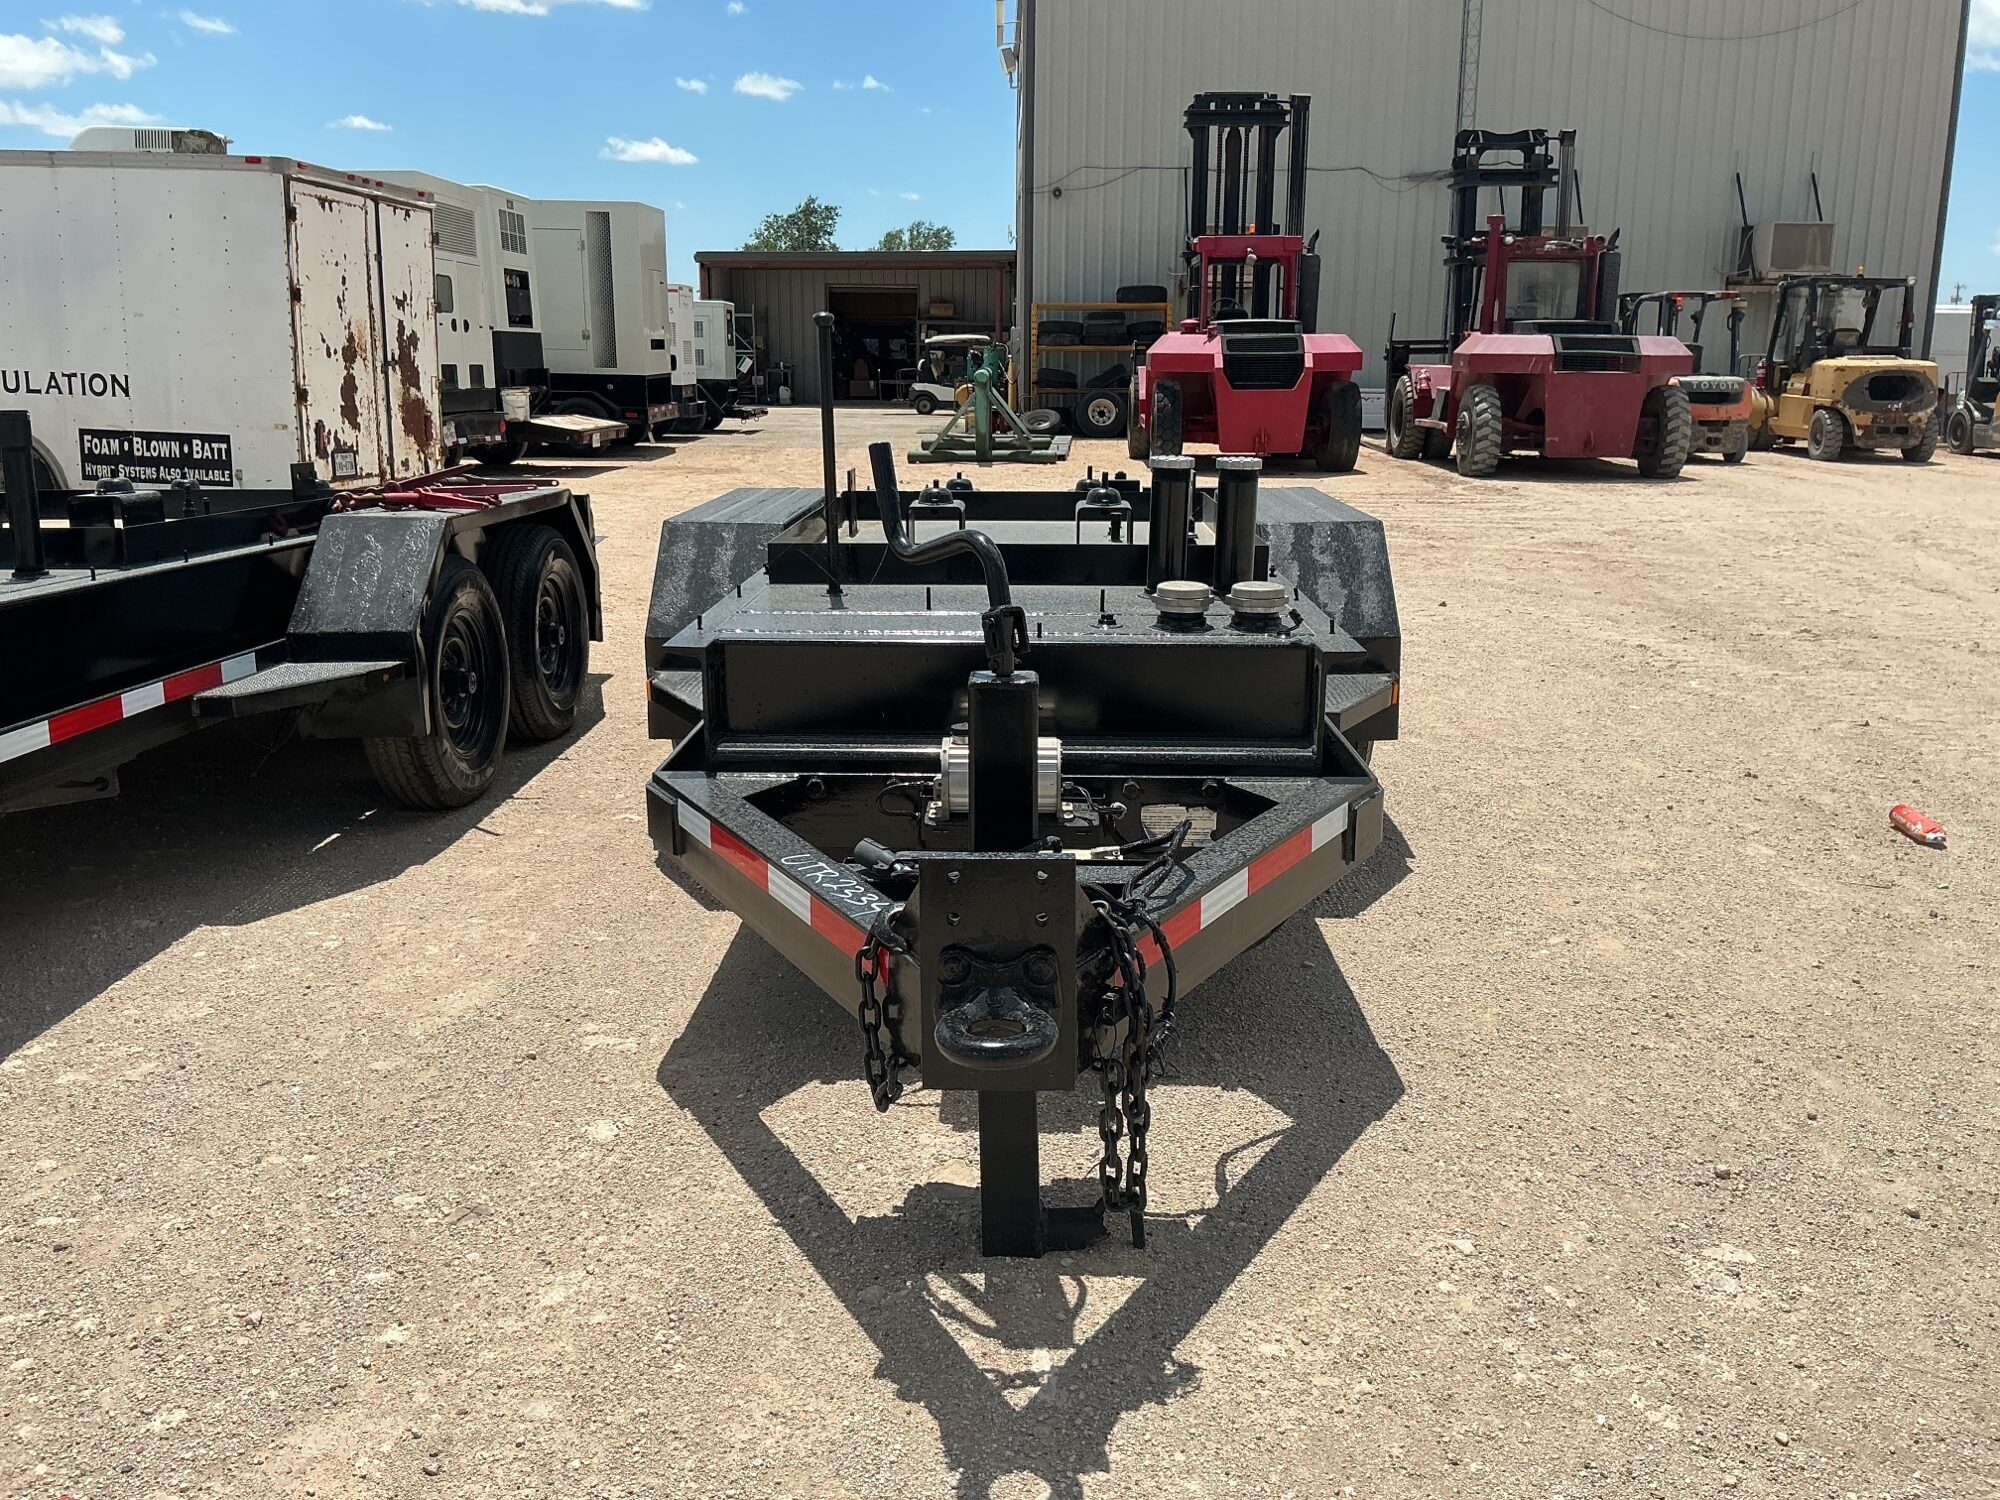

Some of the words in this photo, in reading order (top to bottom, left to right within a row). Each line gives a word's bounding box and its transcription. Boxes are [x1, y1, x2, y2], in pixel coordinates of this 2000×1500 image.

[1, 369, 131, 398] ULATION
[1692, 381, 1740, 390] TOYOTA
[83, 434, 120, 456] FOAM
[133, 436, 180, 458] BLOWN
[192, 438, 228, 461] BATT
[118, 464, 157, 480] SYSTEMS
[159, 466, 182, 481] ALSO
